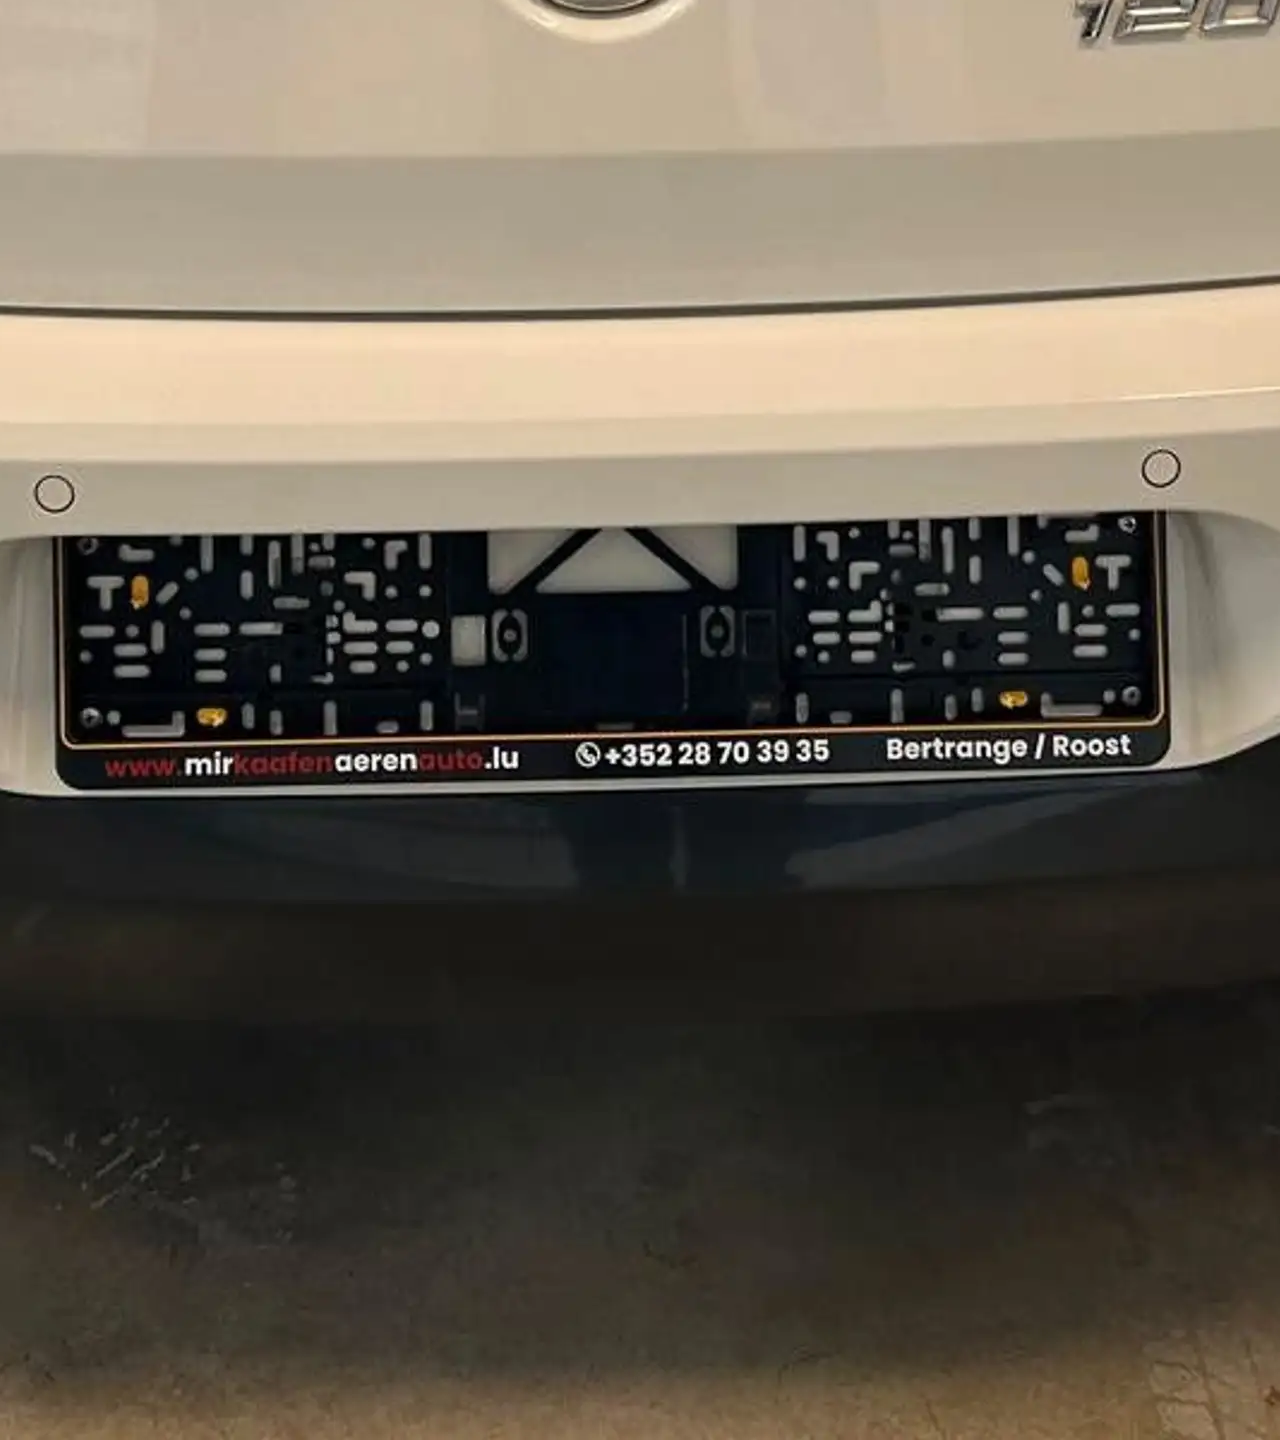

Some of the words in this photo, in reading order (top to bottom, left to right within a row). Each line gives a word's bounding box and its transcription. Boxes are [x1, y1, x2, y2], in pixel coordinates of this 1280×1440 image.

[104, 746, 520, 778] www.mirkaafenaerenauto.lu
[604, 743, 673, 767] +352
[678, 742, 711, 765] 28
[717, 741, 750, 764] 70
[757, 739, 790, 763] 39
[796, 738, 830, 762] 35
[886, 737, 1028, 765] Bertrange
[1052, 733, 1132, 757] Roost
